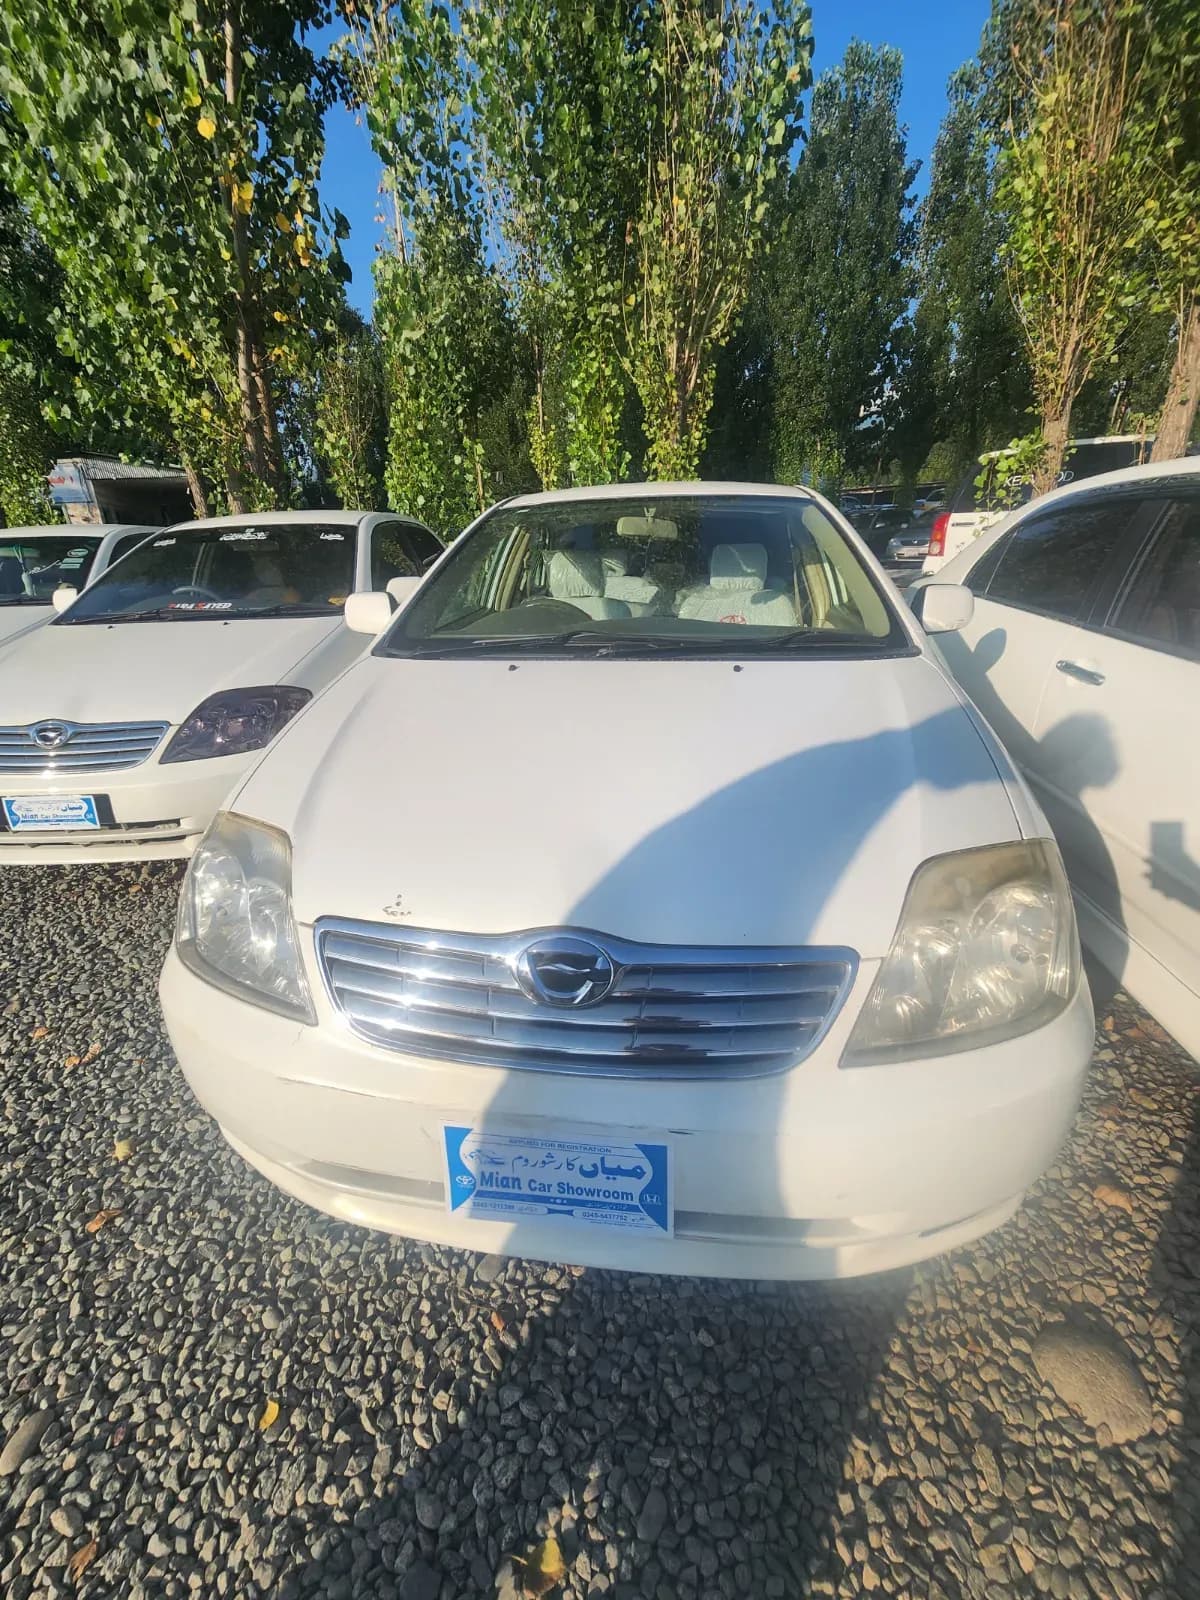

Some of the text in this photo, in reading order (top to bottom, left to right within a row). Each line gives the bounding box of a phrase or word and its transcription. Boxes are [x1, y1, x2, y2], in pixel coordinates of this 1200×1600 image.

[1003, 470, 1074, 487] KEOD
[557, 1143, 612, 1153] REGISTRATION
[480, 1171, 634, 1201] Mian Car Showroom
